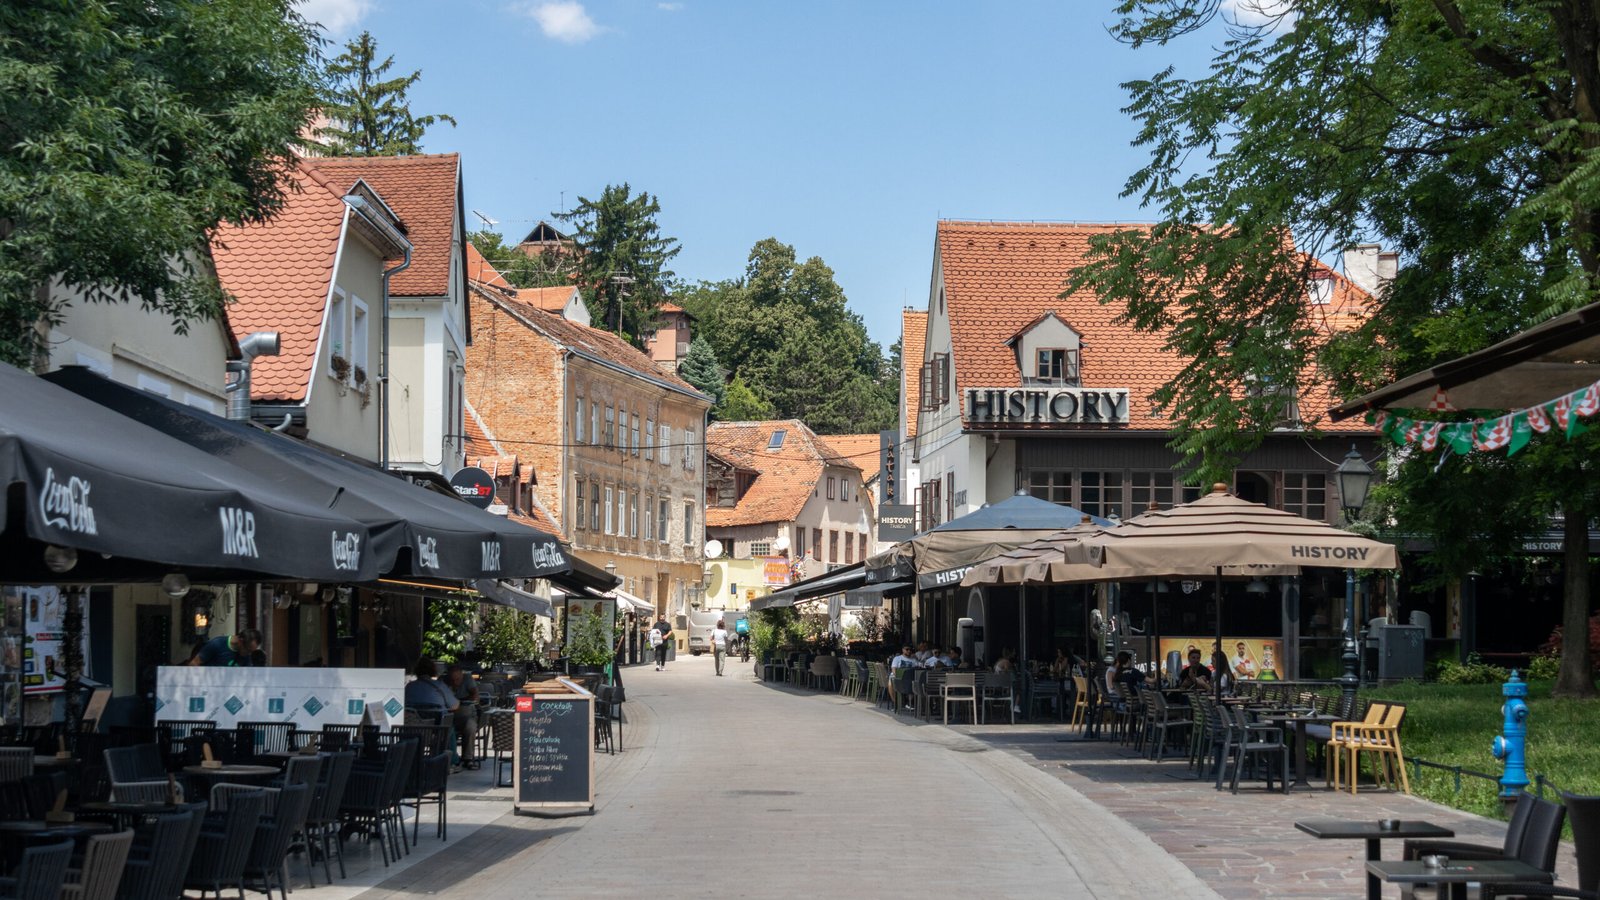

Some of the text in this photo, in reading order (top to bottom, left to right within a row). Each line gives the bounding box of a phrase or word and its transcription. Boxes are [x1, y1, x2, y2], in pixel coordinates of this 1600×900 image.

[967, 389, 1128, 420] HISTORY
[219, 506, 259, 559] M&R
[1522, 541, 1563, 550] HISTORY
[481, 541, 501, 571] M&R
[1291, 545, 1369, 561] HISTORY
